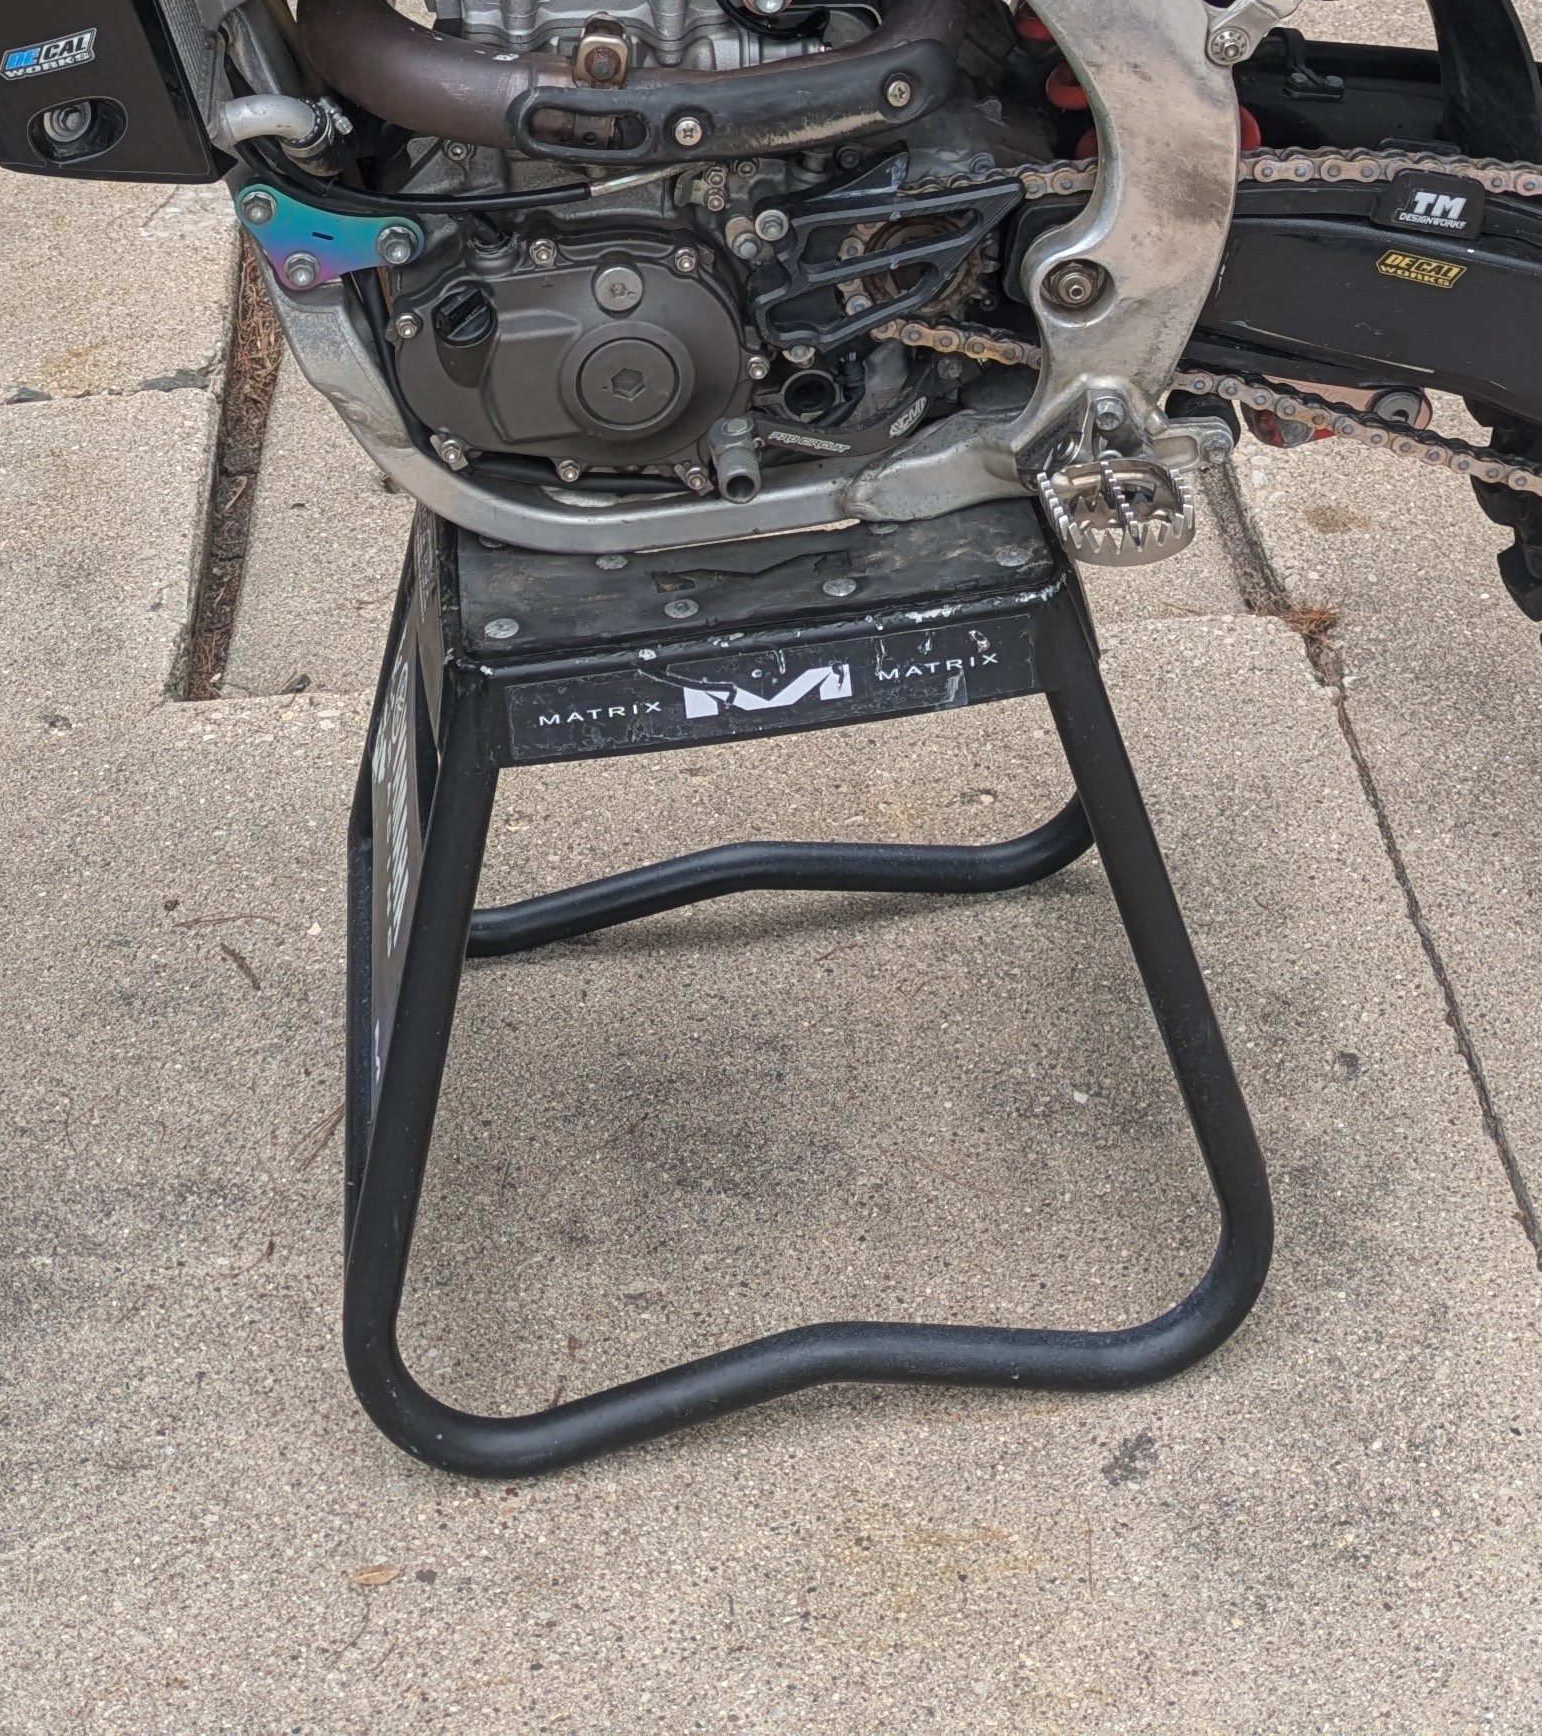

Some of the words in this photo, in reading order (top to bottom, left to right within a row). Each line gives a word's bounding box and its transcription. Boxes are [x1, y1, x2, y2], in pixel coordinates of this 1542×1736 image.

[5, 52, 91, 78] WORKS
[1414, 192, 1467, 219] TM
[1399, 212, 1467, 229] DESIGNWORKS
[1380, 265, 1450, 286] WORKS
[768, 431, 800, 444] PRO
[798, 437, 852, 453] CIRCUIT
[878, 653, 999, 682] MATRIX
[539, 702, 663, 727] MATRIX
